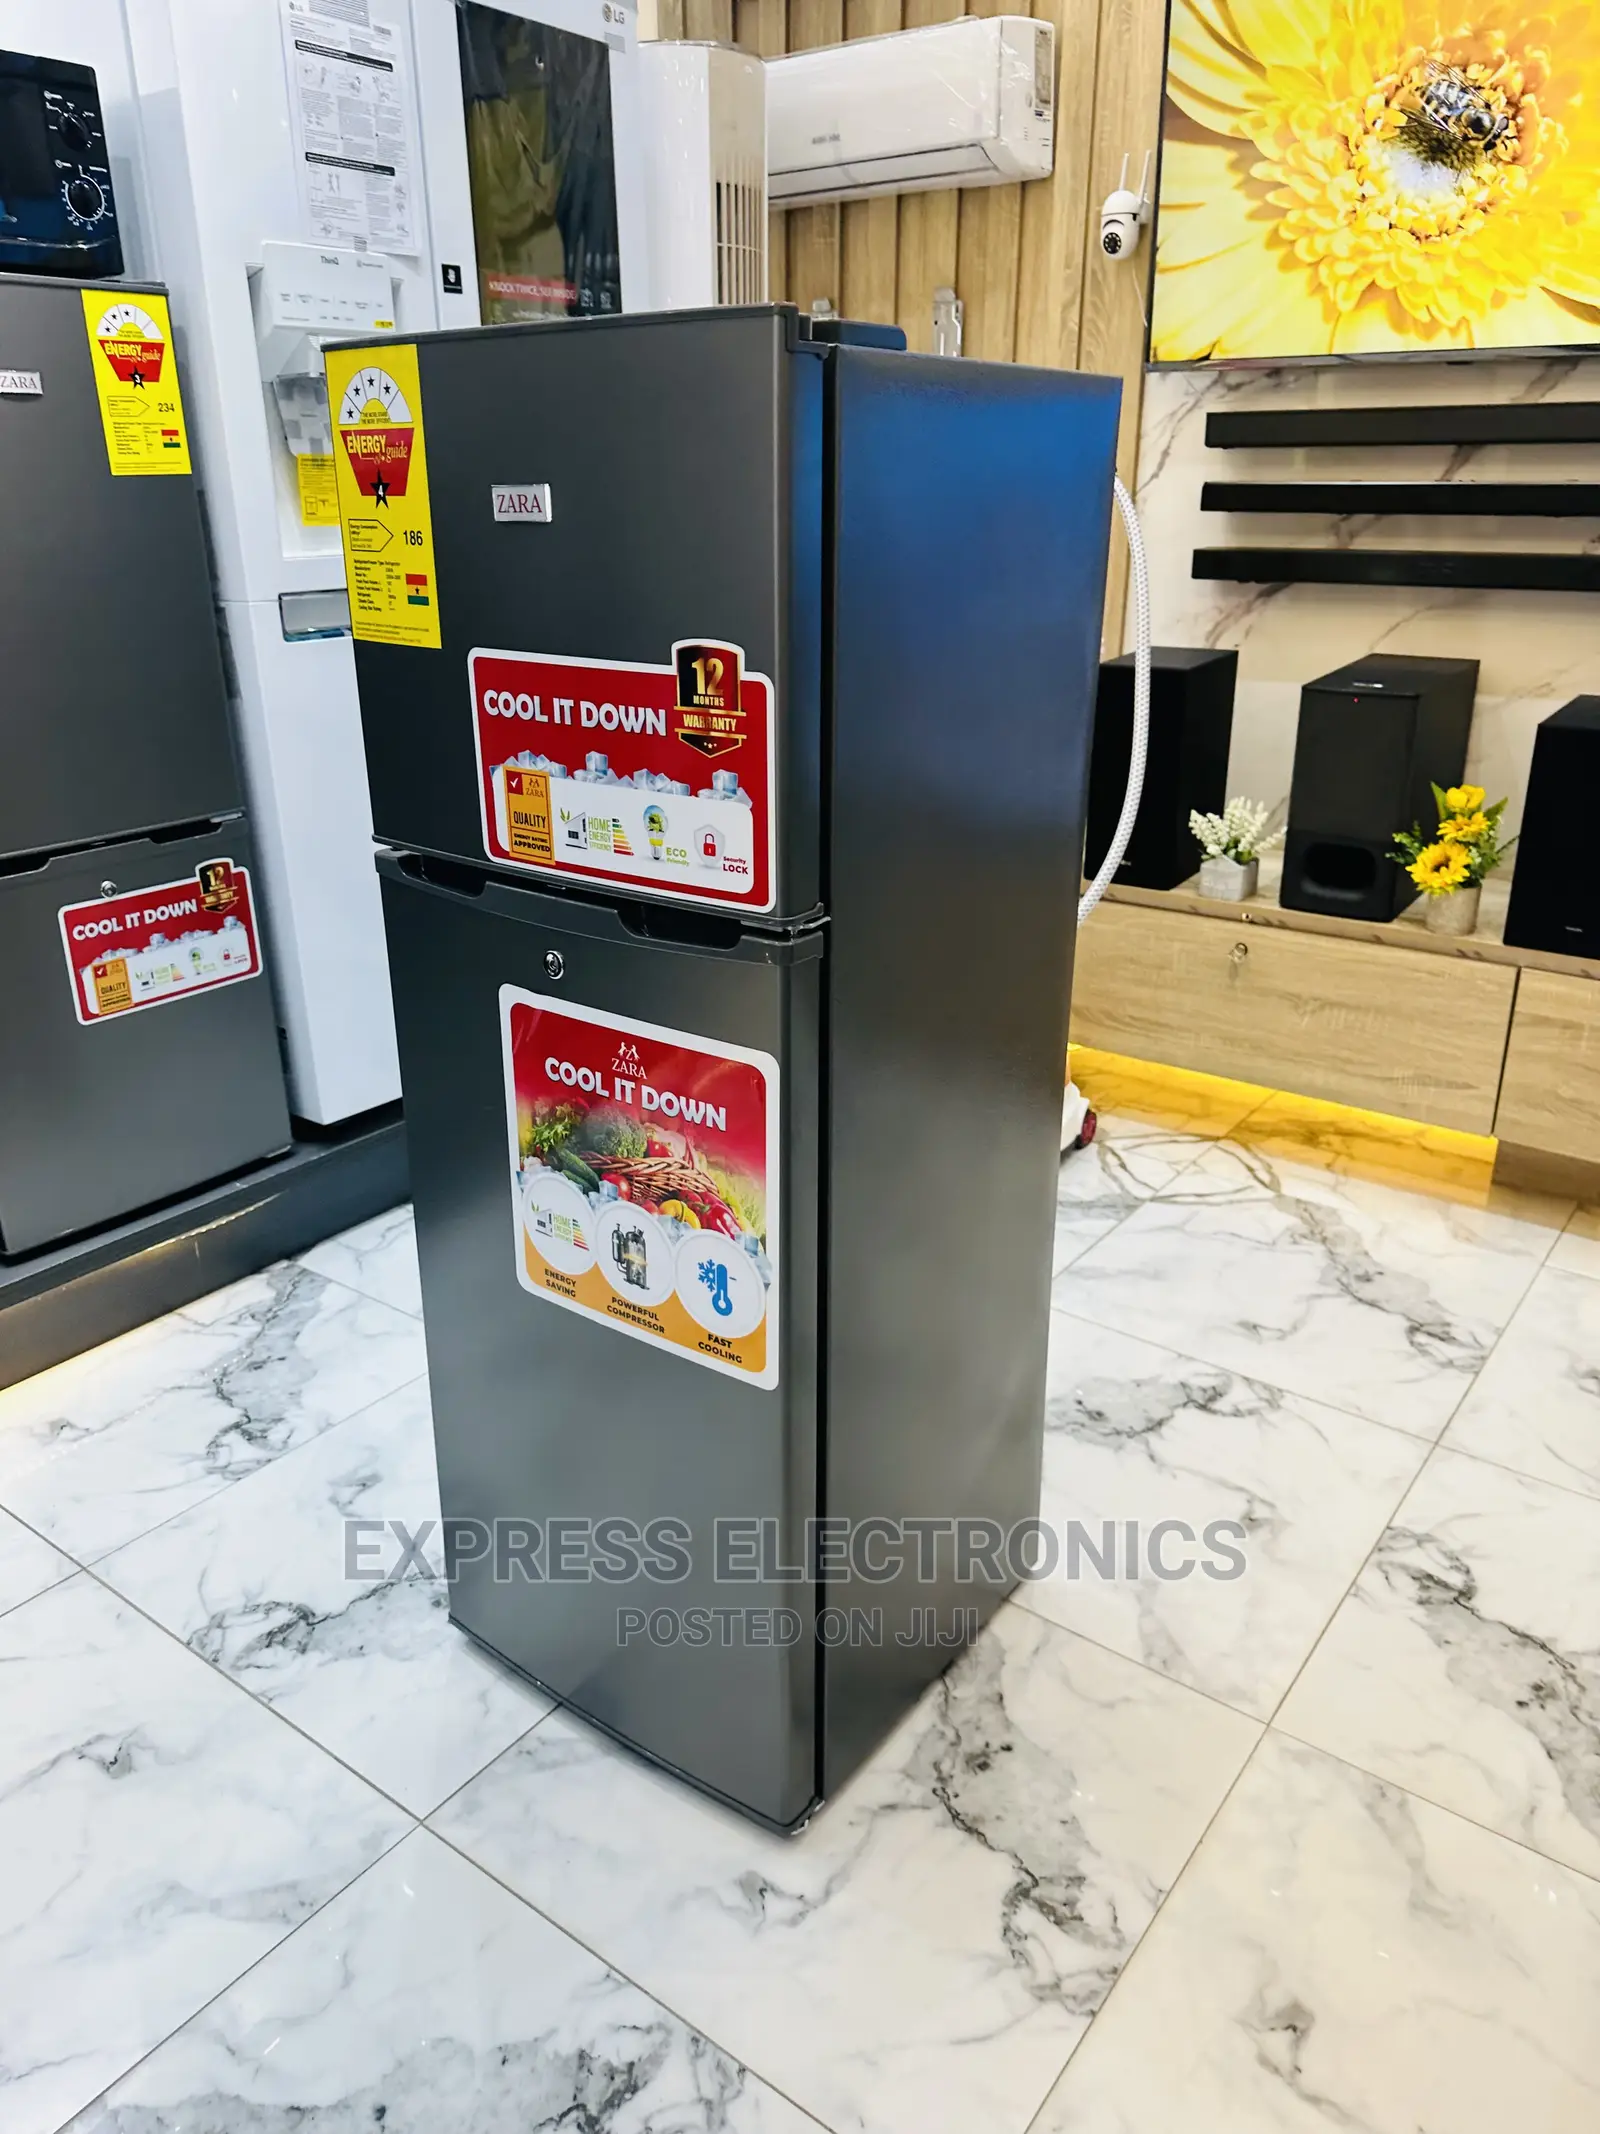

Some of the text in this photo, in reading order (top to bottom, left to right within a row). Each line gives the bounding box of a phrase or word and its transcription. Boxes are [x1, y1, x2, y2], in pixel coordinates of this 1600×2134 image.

[613, 8, 625, 25] LG
[104, 341, 142, 357] ENERGY
[134, 373, 141, 383] 3
[158, 402, 175, 413] 234
[346, 432, 408, 463] ENERGY guide
[378, 484, 384, 497] 4
[497, 493, 542, 513] ZARA
[403, 529, 423, 546] 186
[691, 657, 724, 696] 12
[693, 694, 725, 707] MONTHS
[483, 689, 667, 737] COOL IT DOWN
[683, 713, 737, 732] WARRANTY
[525, 787, 545, 798] ZARA
[513, 811, 546, 828] QUALITY
[588, 816, 612, 832] HOME
[513, 839, 551, 852] APPROVED
[666, 847, 687, 858] ECO
[723, 863, 749, 875] LOCK
[72, 898, 198, 941] COOL IT DOWN
[611, 1057, 648, 1080] ZARA
[544, 1056, 727, 1132] COOL IT DOWN
[544, 1267, 577, 1288] ENERGY
[545, 1278, 577, 1298] SAVING
[611, 1295, 660, 1321] POWERFUL
[606, 1304, 665, 1334] COMPRESSOR
[707, 1333, 733, 1349] FAST
[697, 1341, 743, 1364] COOLING
